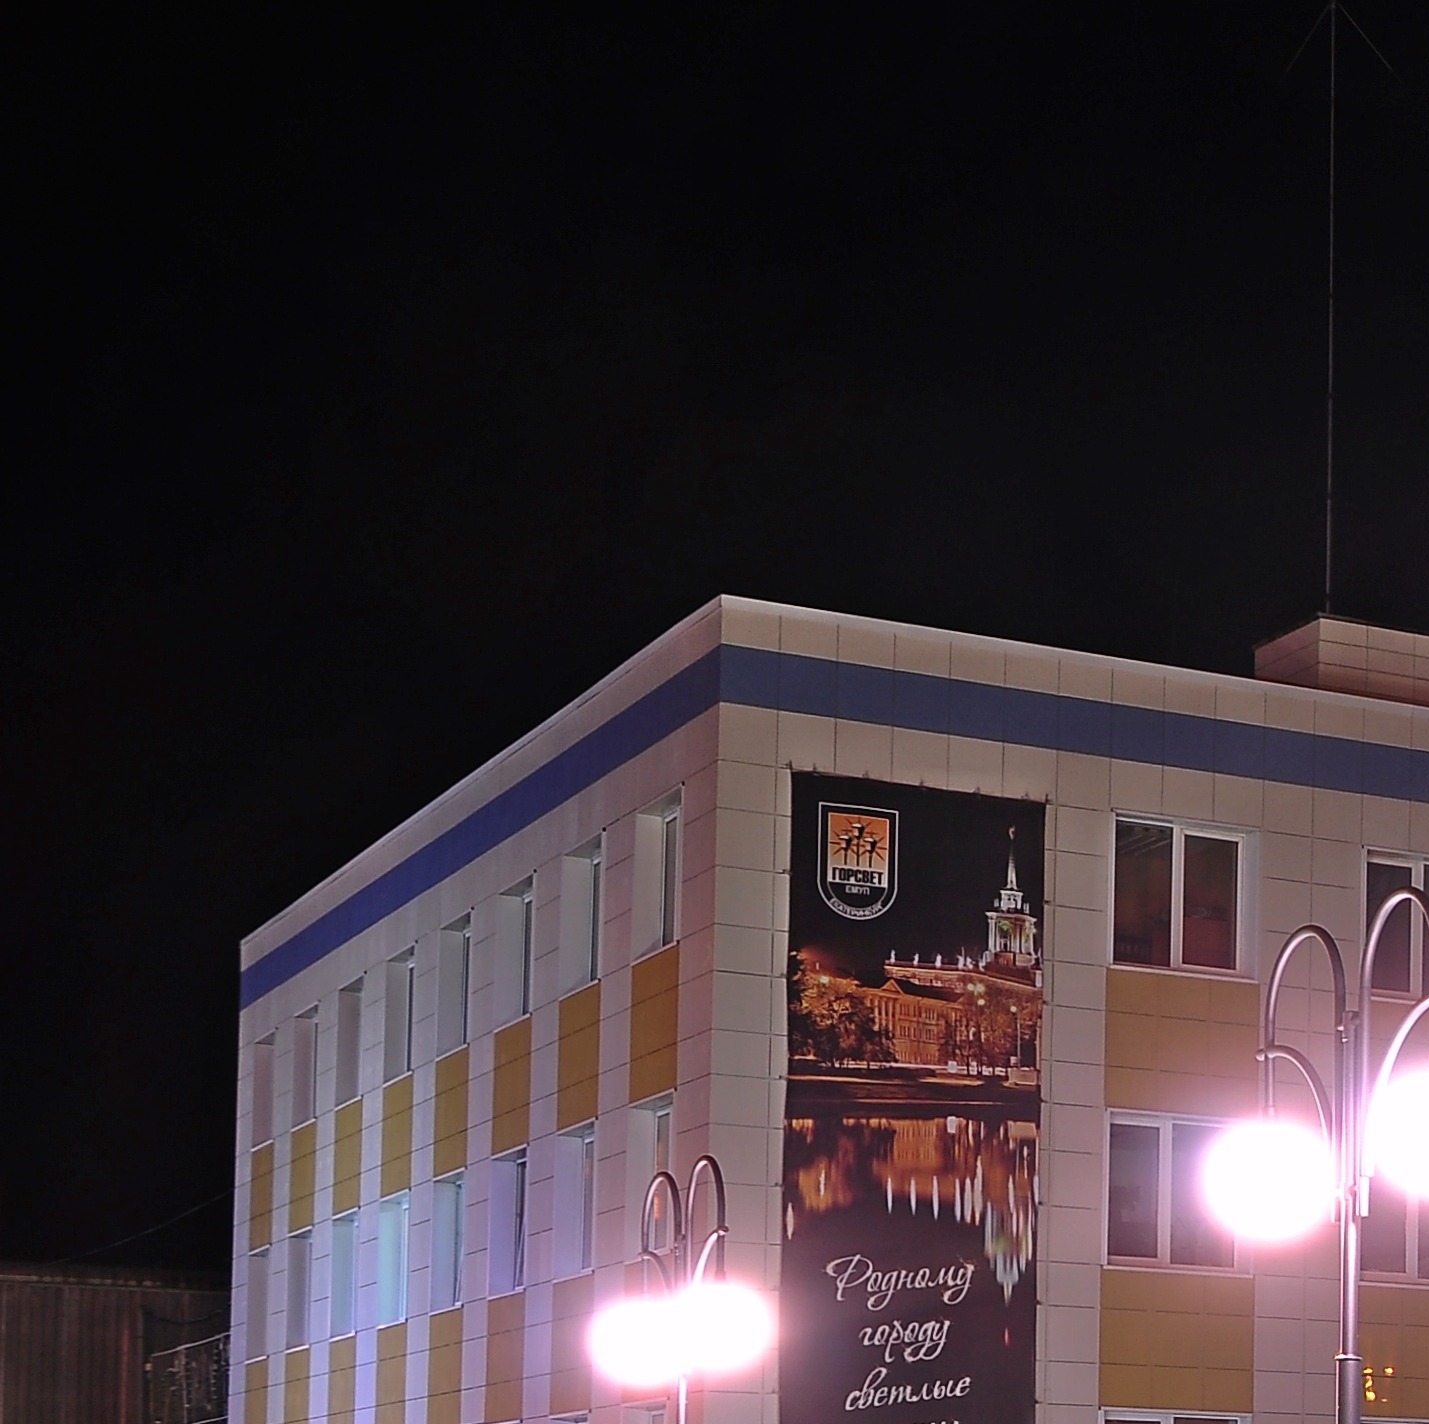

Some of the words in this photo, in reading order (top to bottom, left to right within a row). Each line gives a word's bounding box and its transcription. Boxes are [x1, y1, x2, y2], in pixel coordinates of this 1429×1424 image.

[832, 867, 884, 885] ГОРСВЕТ
[826, 1254, 975, 1310] Родному
[859, 1319, 951, 1362] городу
[845, 1367, 971, 1411] светлые
